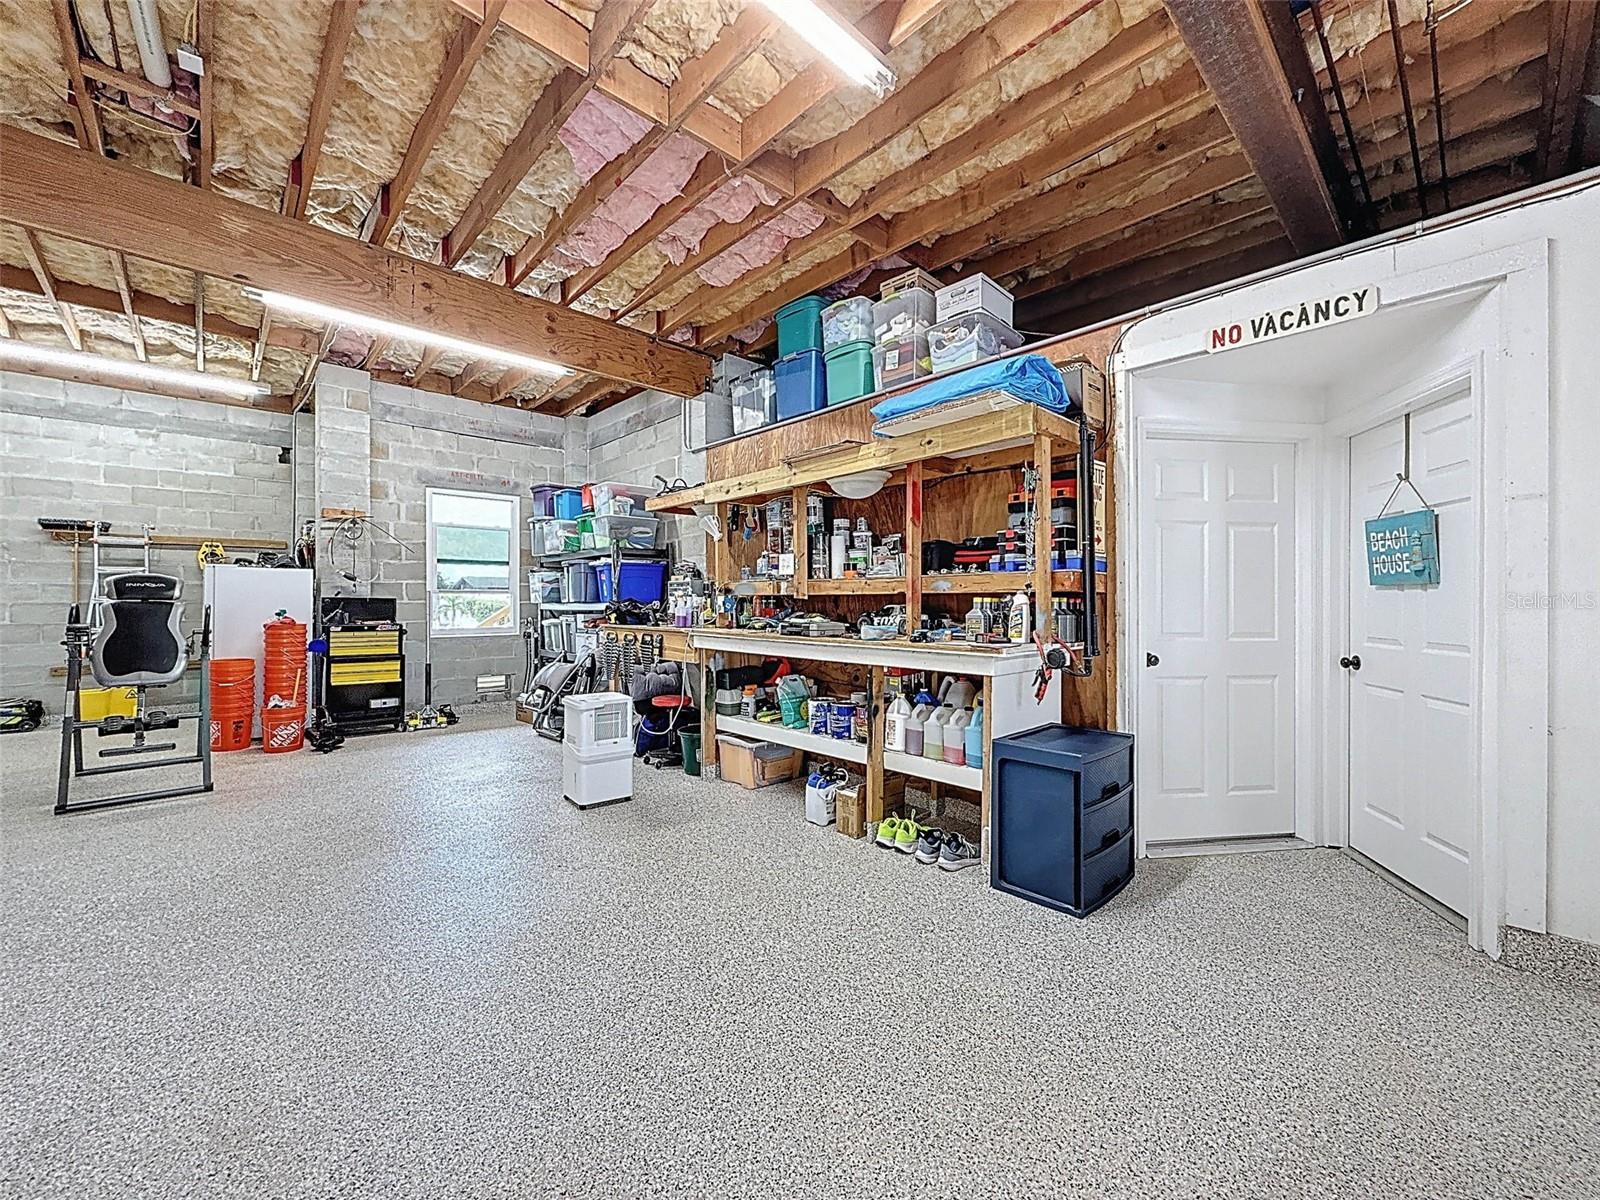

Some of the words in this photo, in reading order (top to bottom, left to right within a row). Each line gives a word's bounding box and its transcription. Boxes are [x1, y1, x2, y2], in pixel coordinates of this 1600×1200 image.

[1212, 324, 1242, 349] NO
[1250, 288, 1369, 339] VACANCY
[1370, 526, 1409, 553] BEACH
[1372, 552, 1411, 576] HOUSE
